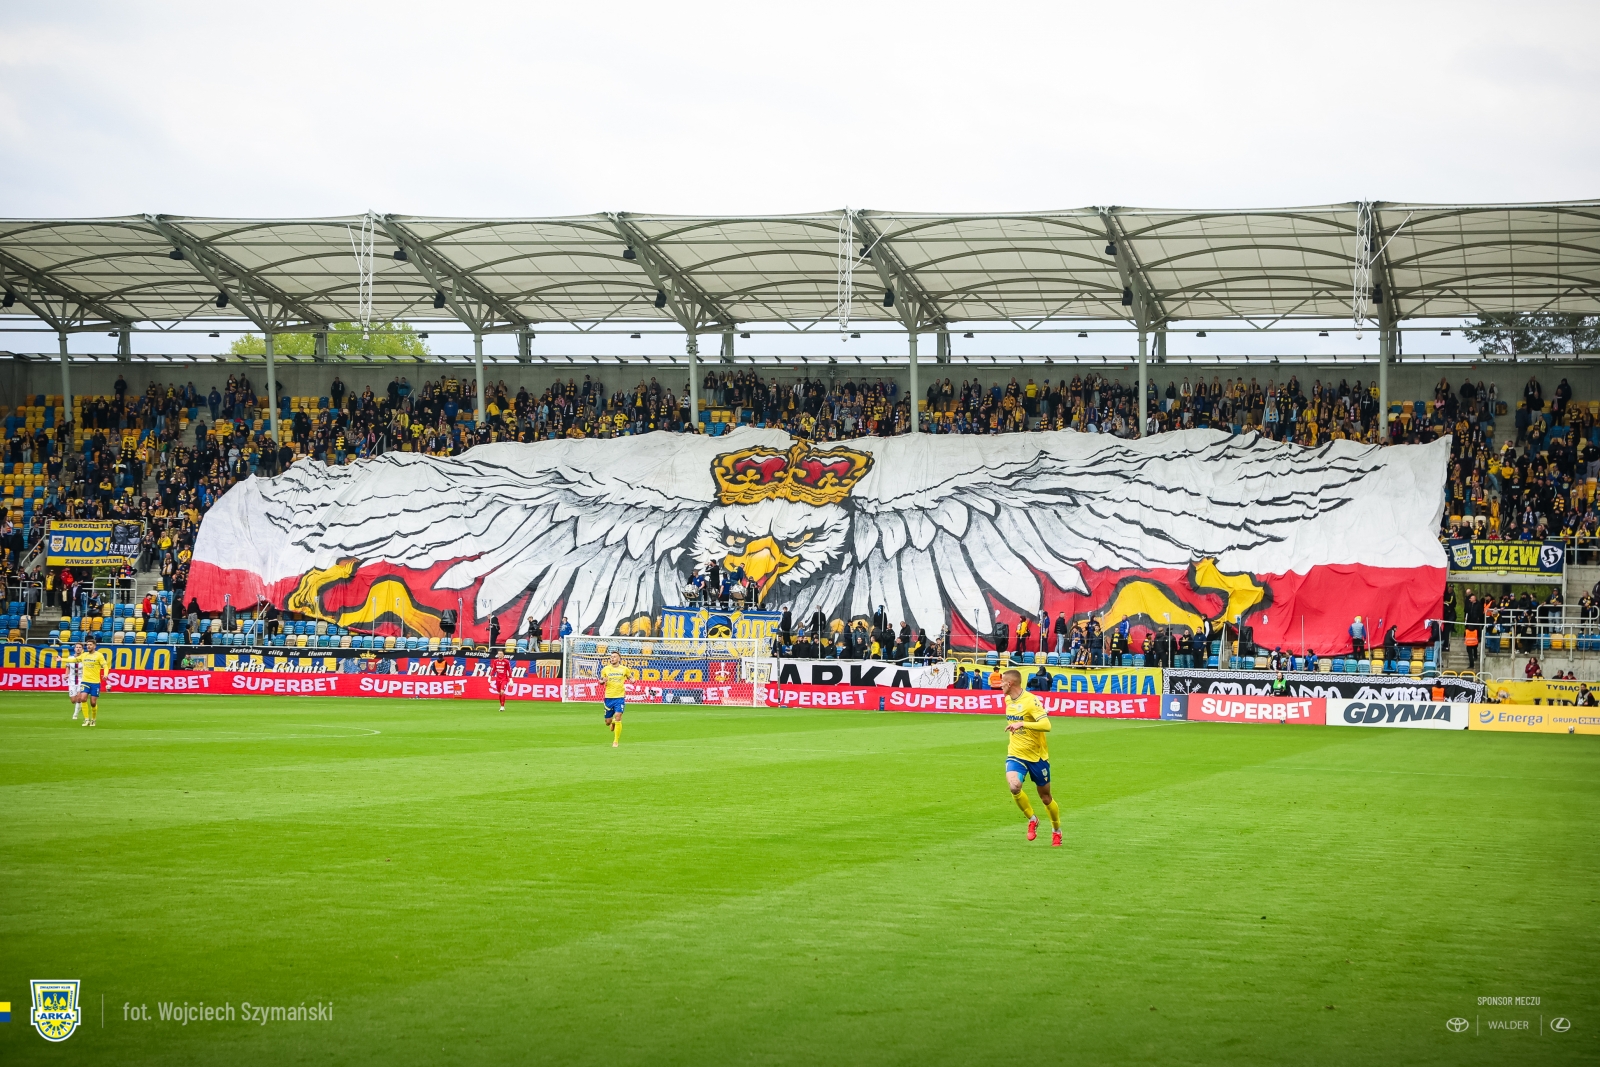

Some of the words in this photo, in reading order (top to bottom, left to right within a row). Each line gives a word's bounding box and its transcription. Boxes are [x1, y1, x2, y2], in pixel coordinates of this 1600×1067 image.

[1473, 545, 1540, 566] TCZEW
[106, 673, 211, 690] SUPERBET
[232, 675, 338, 692] SUPERBET
[359, 677, 467, 695] SUPERBET
[755, 688, 867, 706] SUPERBET
[890, 691, 1005, 710] SUPERBET
[1201, 697, 1313, 719] SUPERBET
[1343, 703, 1451, 723] GDYNIA
[1498, 712, 1543, 726] Energa
